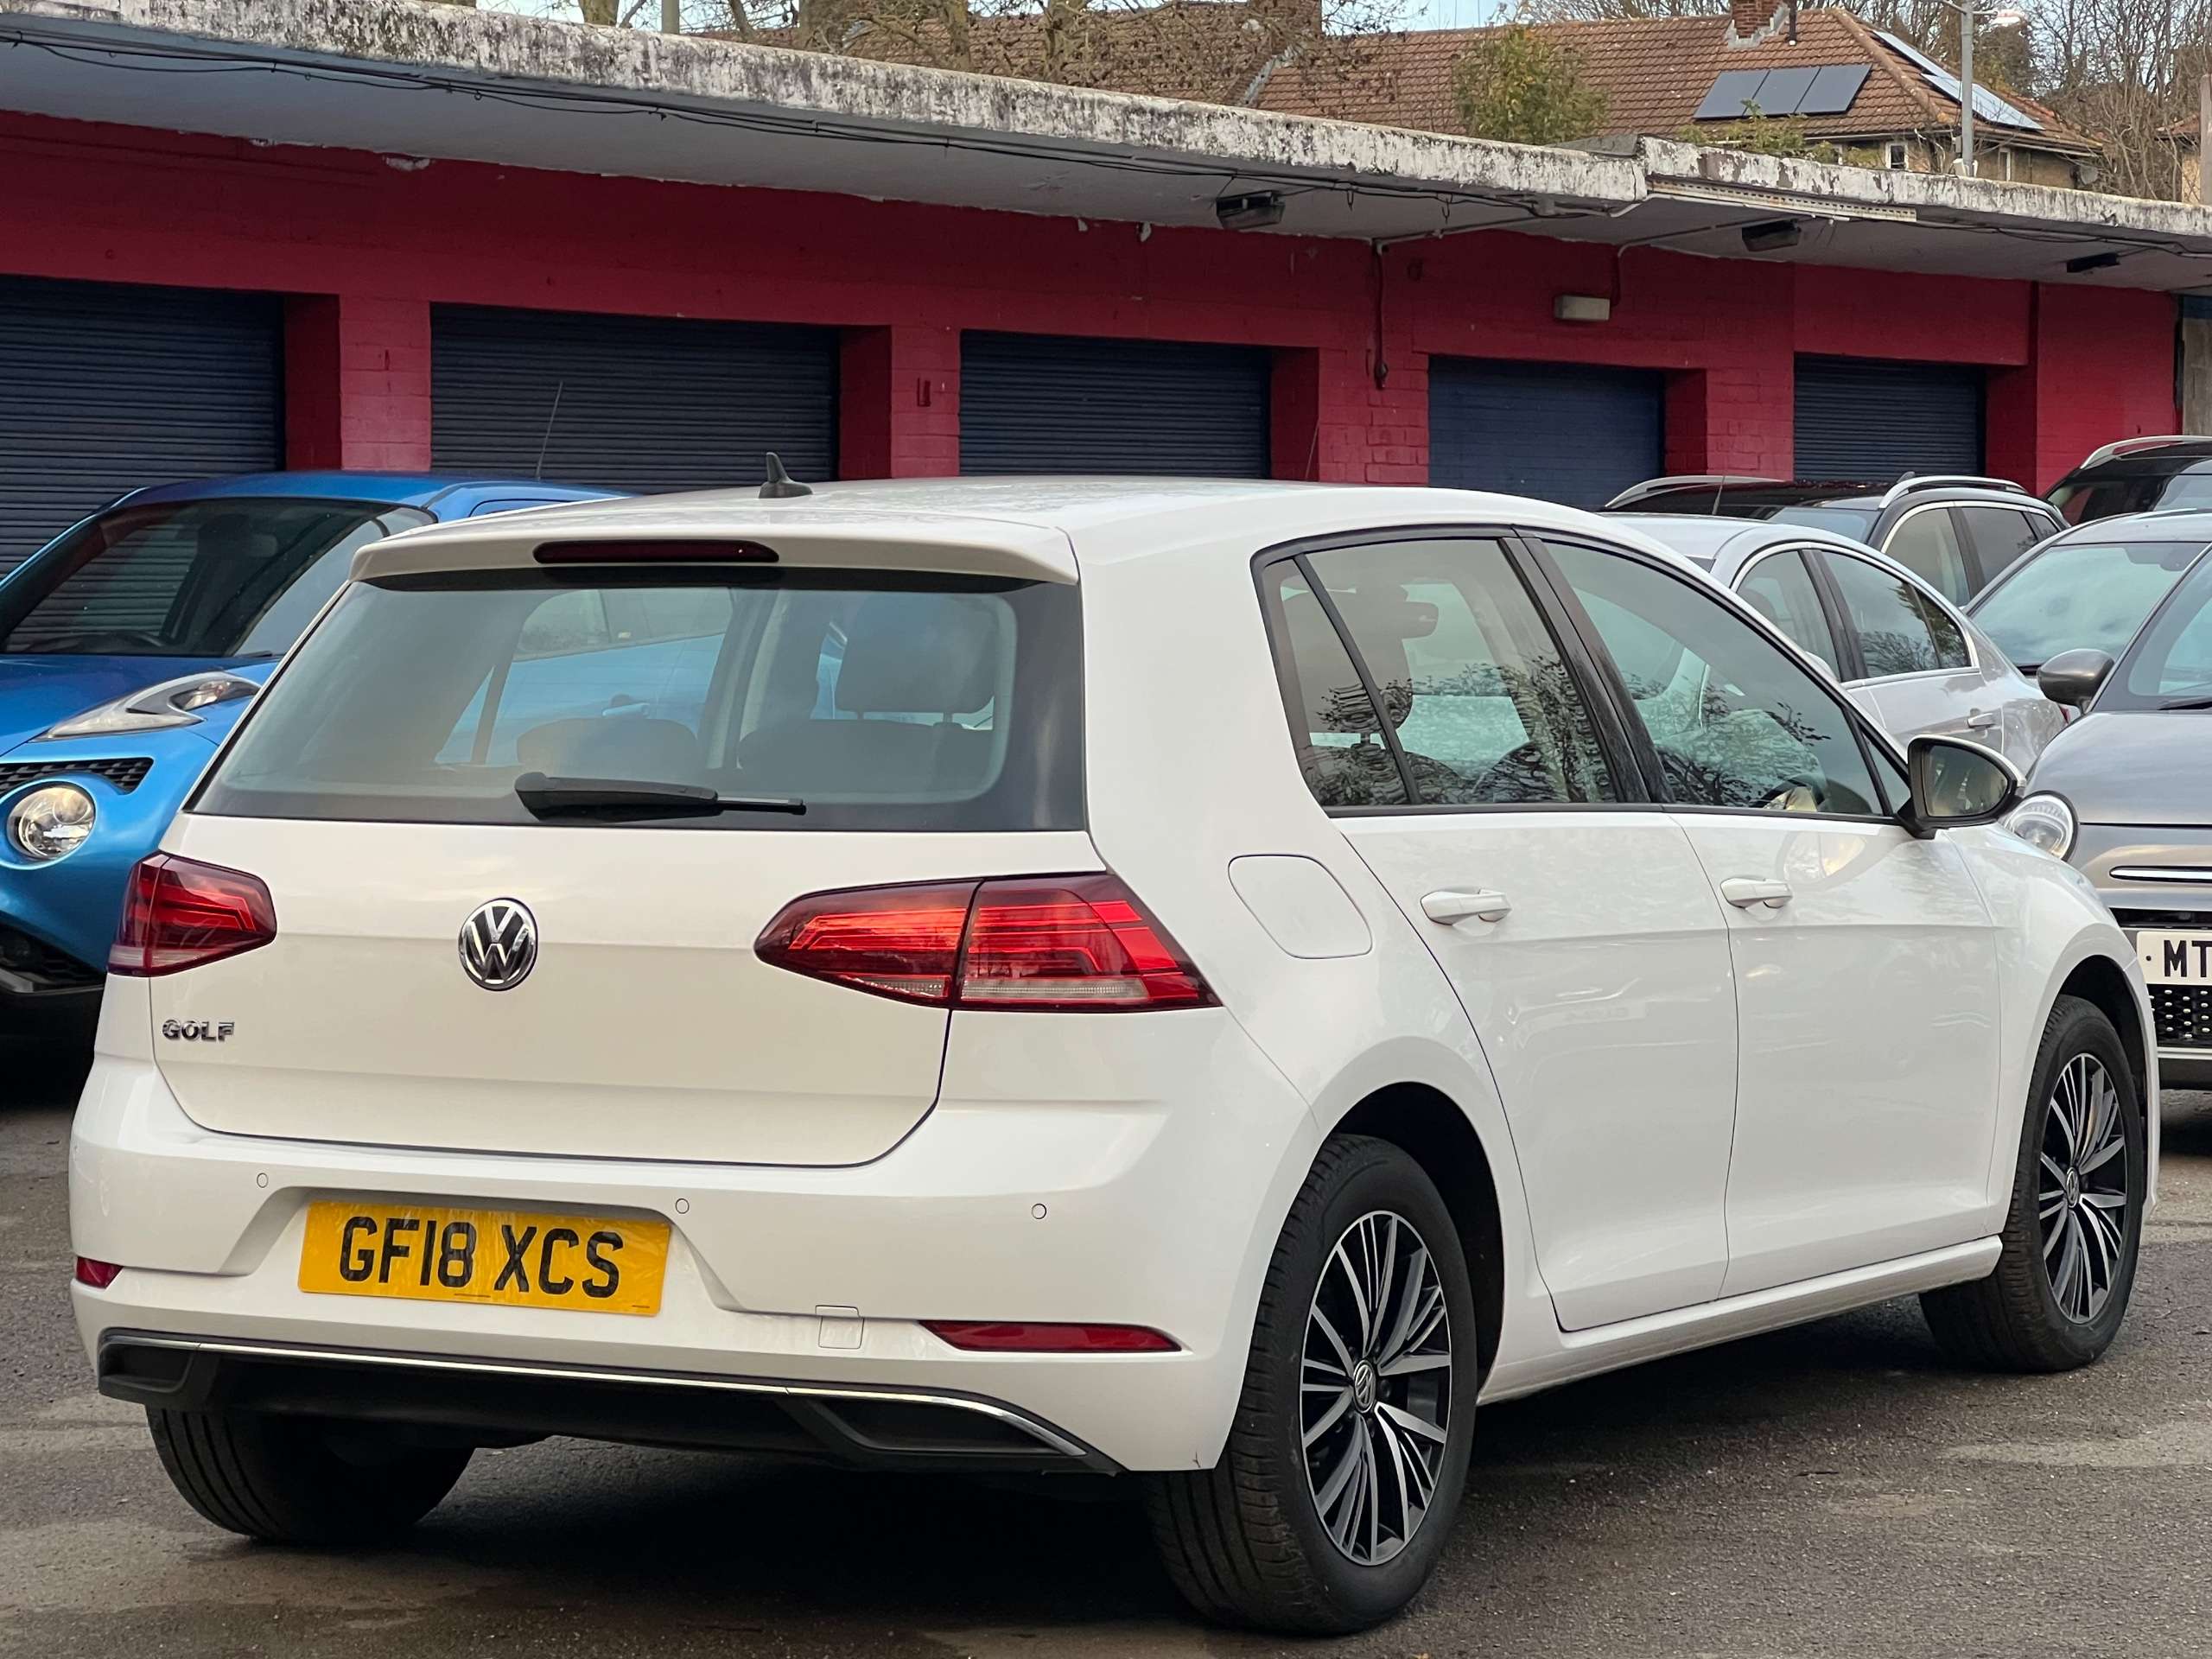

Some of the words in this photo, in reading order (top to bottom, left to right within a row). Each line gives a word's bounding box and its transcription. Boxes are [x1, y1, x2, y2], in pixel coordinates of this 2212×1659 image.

[461, 899, 537, 987] VW
[2164, 939, 2212, 978] MT
[162, 1019, 235, 1042] GOLF
[339, 1216, 478, 1288] GF18
[493, 1224, 625, 1299] XCS
